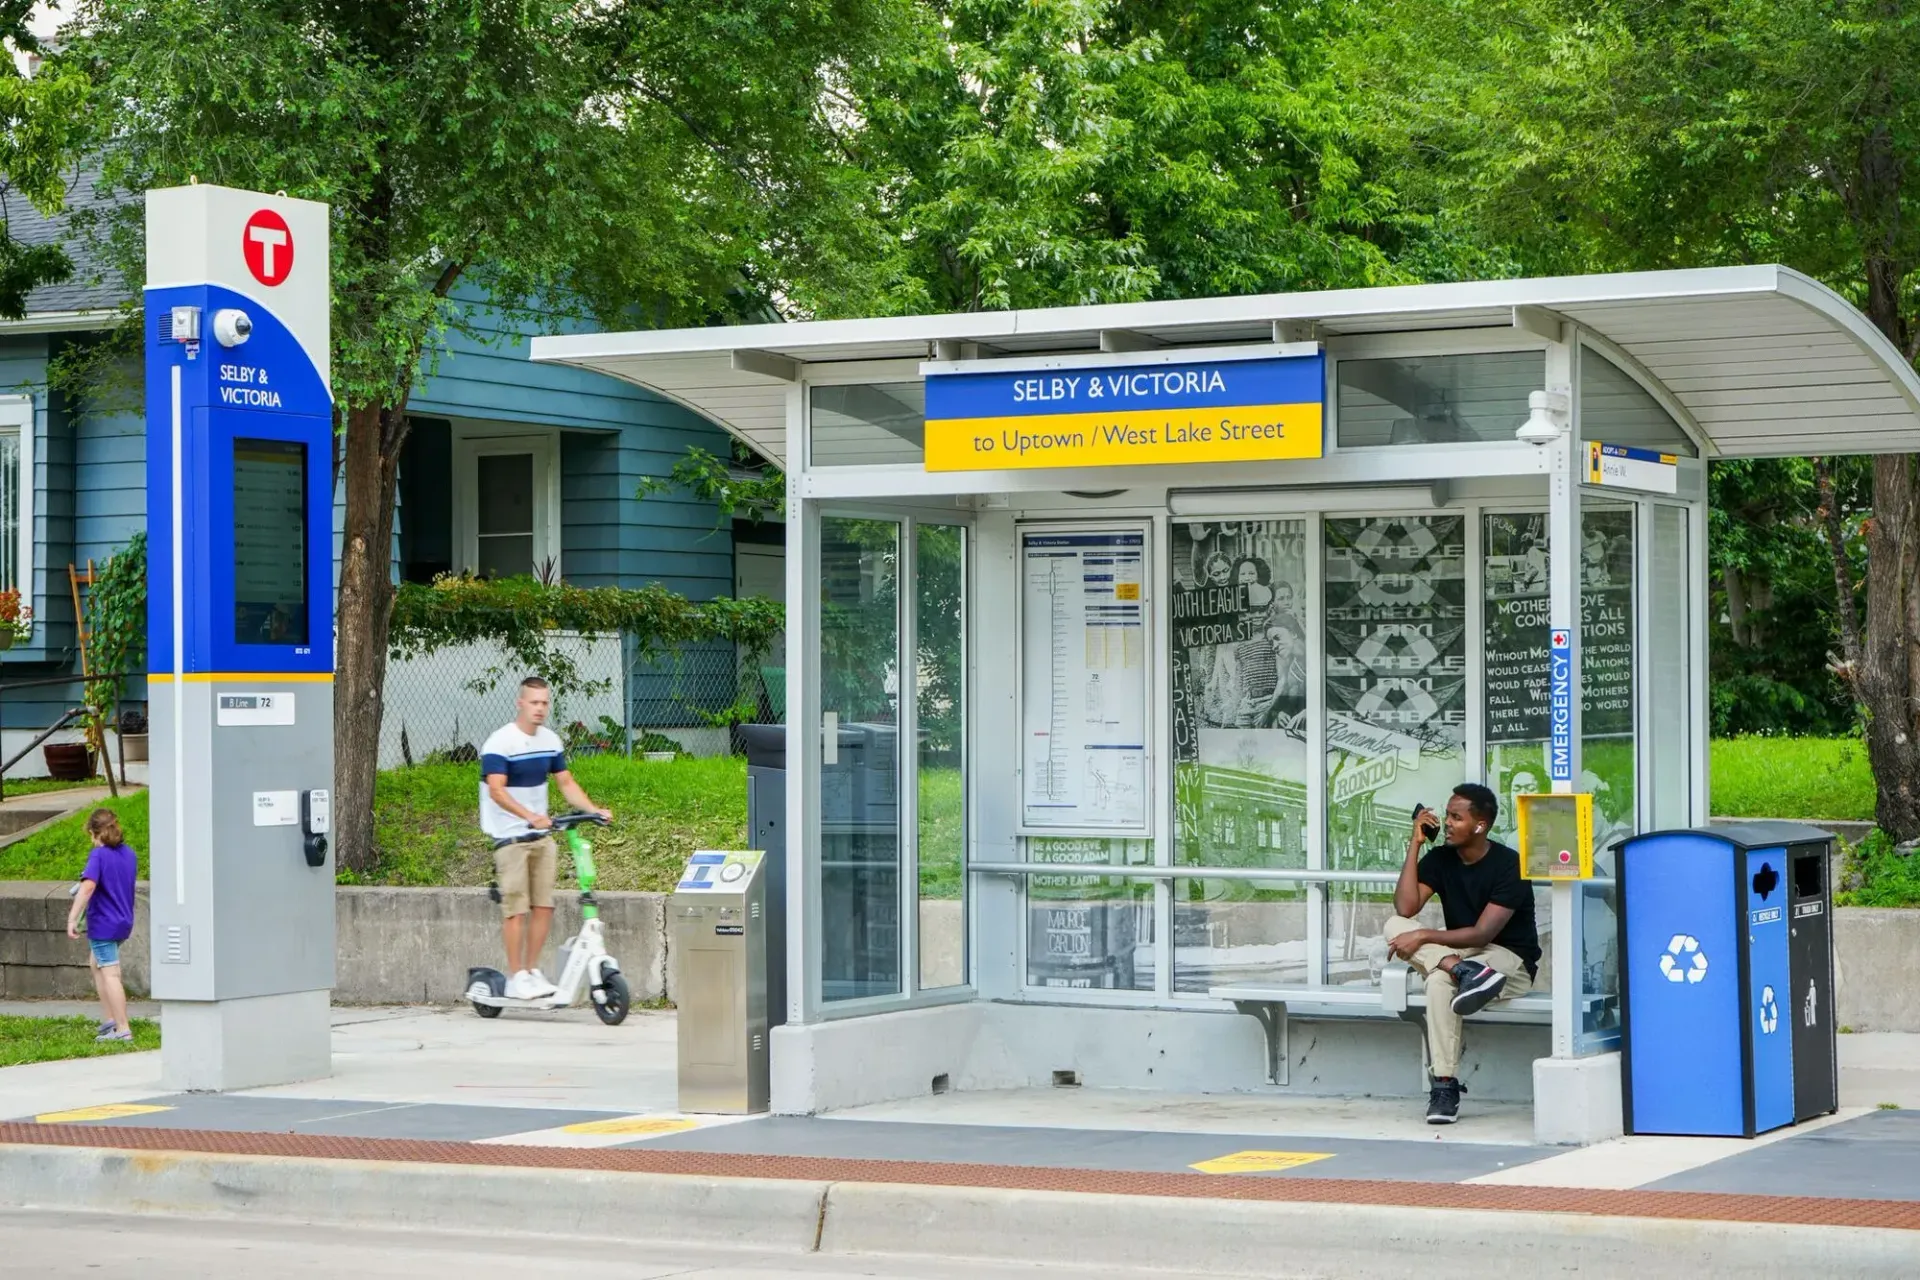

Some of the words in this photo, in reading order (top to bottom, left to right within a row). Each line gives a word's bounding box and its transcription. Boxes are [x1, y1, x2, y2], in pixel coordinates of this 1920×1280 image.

[249, 225, 287, 278] T
[220, 364, 256, 383] SELBY
[259, 368, 269, 385] &
[1013, 376, 1080, 402] SELBY
[1088, 377, 1104, 398] &
[1109, 370, 1226, 397] VICTORIA
[220, 386, 282, 408] VICTORIA
[974, 435, 994, 452] to
[1003, 430, 1083, 455] Uptown
[1091, 425, 1099, 447] /
[1103, 424, 1157, 447] West
[1166, 422, 1211, 443] Lake
[1220, 419, 1284, 441] Street
[1201, 585, 1248, 617] LEAGUE
[1581, 593, 1605, 608] OVE
[1599, 607, 1626, 621] ALL
[1180, 624, 1233, 647] VICTORIA
[1237, 620, 1252, 641] ST
[1581, 622, 1626, 637] TIONS
[1486, 649, 1528, 662] WITHOUT
[1599, 644, 1631, 653] WORLD
[1487, 666, 1519, 676] WOULD
[1488, 680, 1520, 690] WOULD
[1523, 678, 1551, 688] FADE.
[1597, 671, 1630, 682] WOULD
[1183, 663, 1195, 714] PHONE
[1489, 695, 1515, 705] FALL.
[1581, 685, 1629, 697] MOTHERS
[229, 698, 235, 707] B
[235, 698, 249, 708] Line
[261, 697, 271, 707] 72
[1490, 708, 1520, 719] THERE
[1523, 706, 1551, 716] WOUL
[1596, 699, 1629, 710] WORLD
[1553, 655, 1569, 778] EMERGENCY
[1491, 724, 1502, 734] AT
[1507, 722, 1529, 732] ALL.
[1335, 757, 1395, 800] RONDO
[1034, 853, 1044, 862] BE
[1044, 853, 1052, 862] A
[1052, 852, 1081, 863] GOOD
[1082, 850, 1109, 862] ADAM
[1034, 875, 1068, 886] MOTHER
[1069, 874, 1100, 886] EARTH
